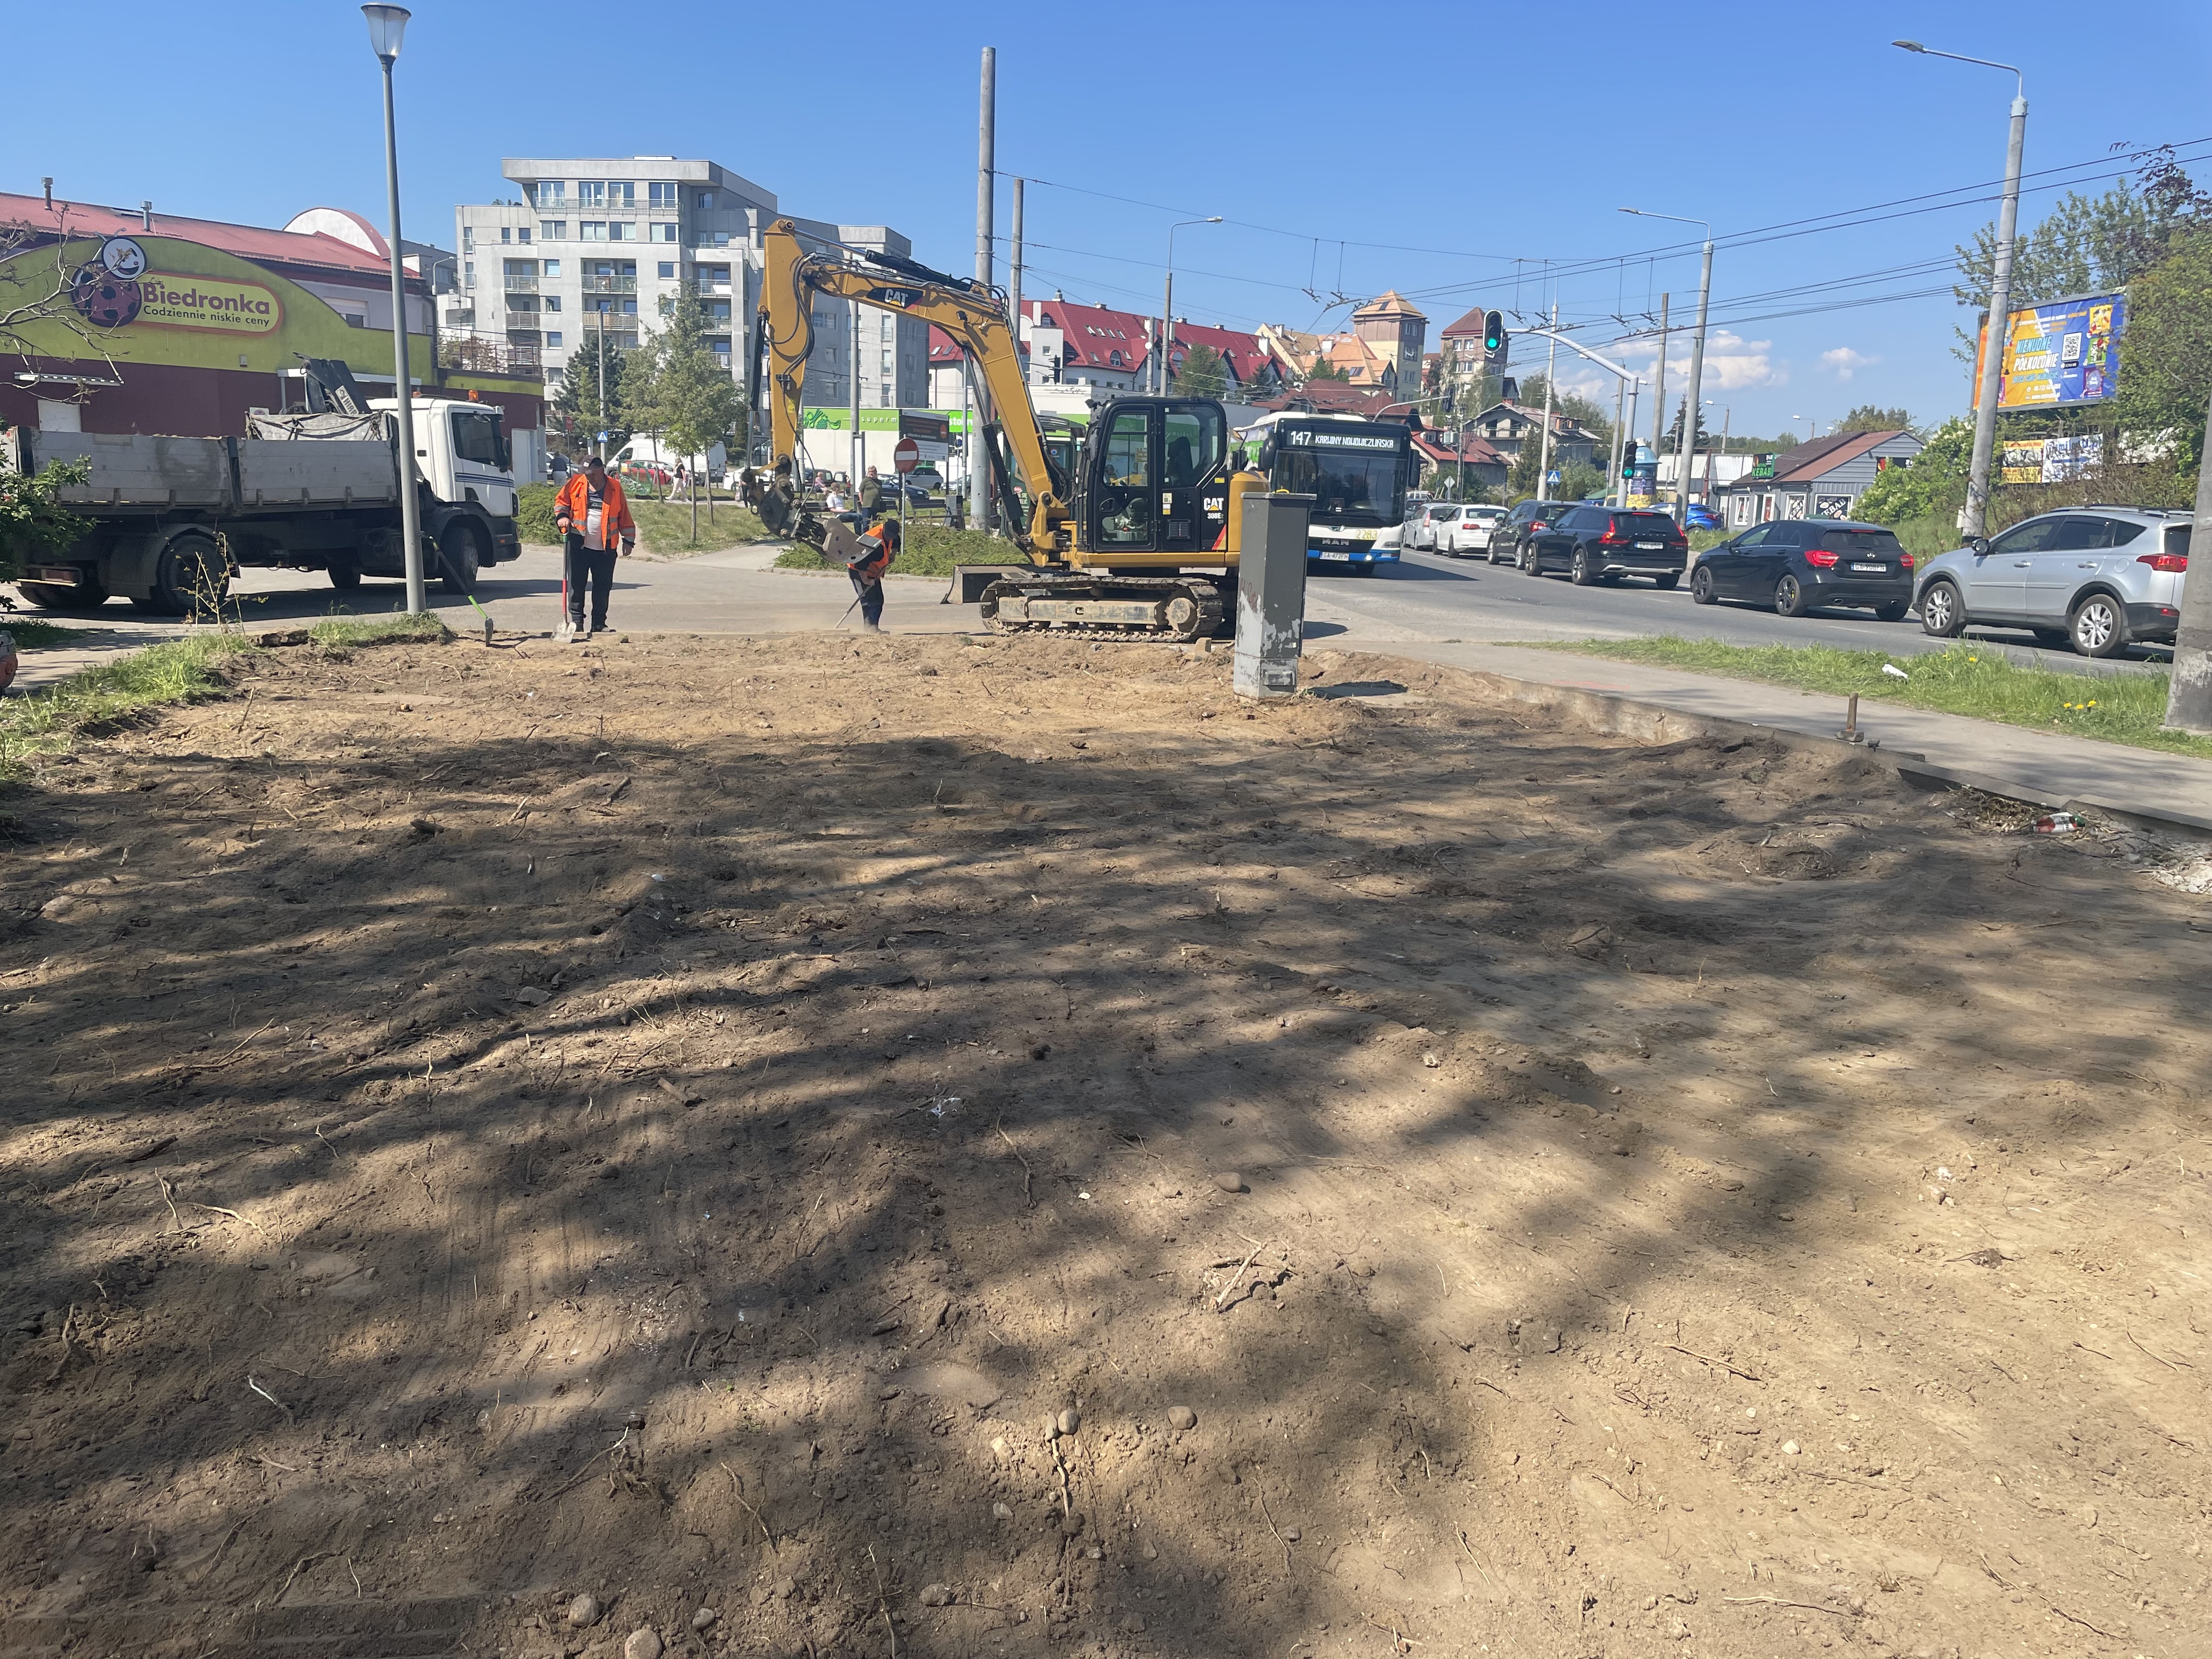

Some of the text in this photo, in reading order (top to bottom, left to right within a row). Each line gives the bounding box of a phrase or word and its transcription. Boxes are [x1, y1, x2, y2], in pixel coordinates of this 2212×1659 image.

[143, 283, 270, 315] Biedronka
[884, 289, 909, 307] CAT
[143, 306, 269, 327] Codziennie niskie ceny
[2015, 335, 2053, 354] NIENUDNE
[1290, 431, 1311, 445] 147
[1315, 435, 1341, 445] KARWINY
[1752, 467, 1771, 477] KEBAB
[1204, 498, 1224, 511] CAT
[1821, 498, 1846, 516] EBAB
[1356, 529, 1377, 539] 2263
